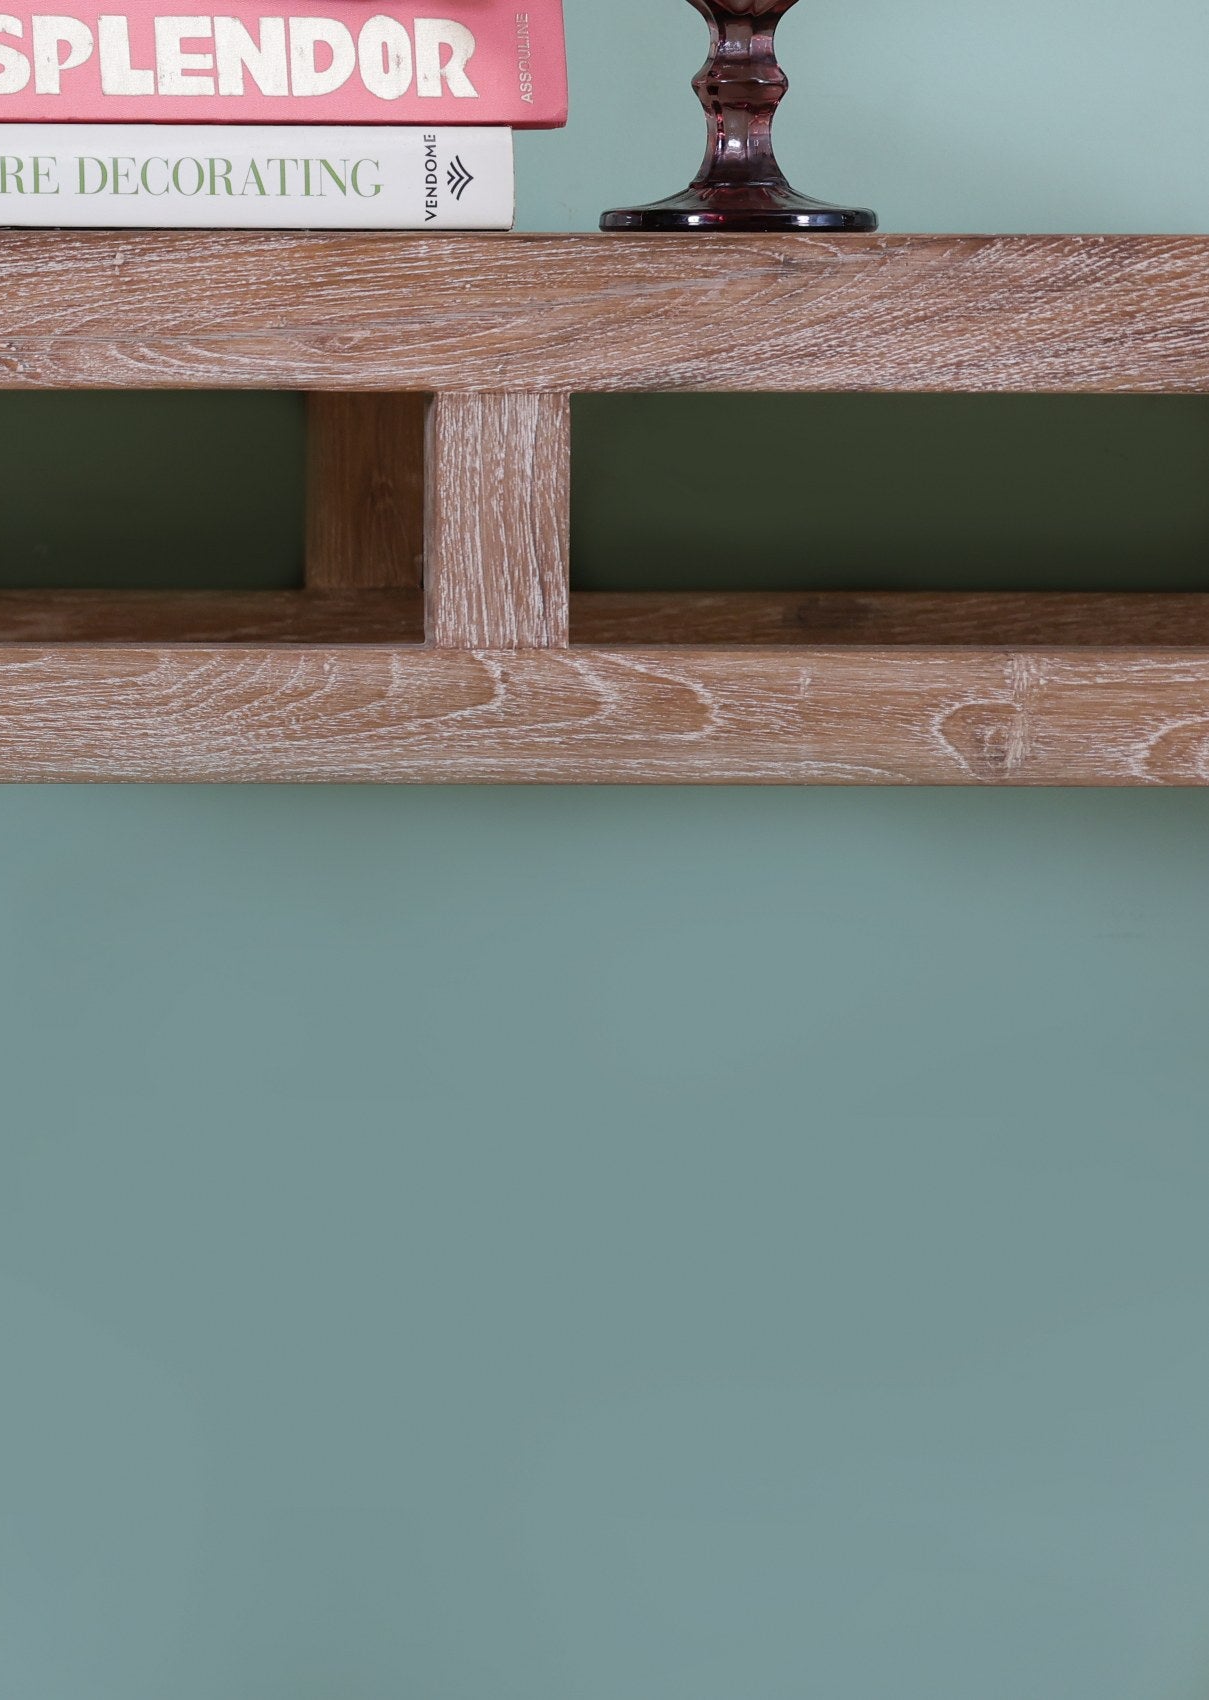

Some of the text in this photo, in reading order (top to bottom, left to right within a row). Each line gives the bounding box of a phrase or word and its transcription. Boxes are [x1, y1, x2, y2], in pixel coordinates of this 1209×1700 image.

[516, 13, 534, 104] ASSOULINE
[74, 155, 385, 198] DECORATING
[424, 133, 438, 222] VENDOME
